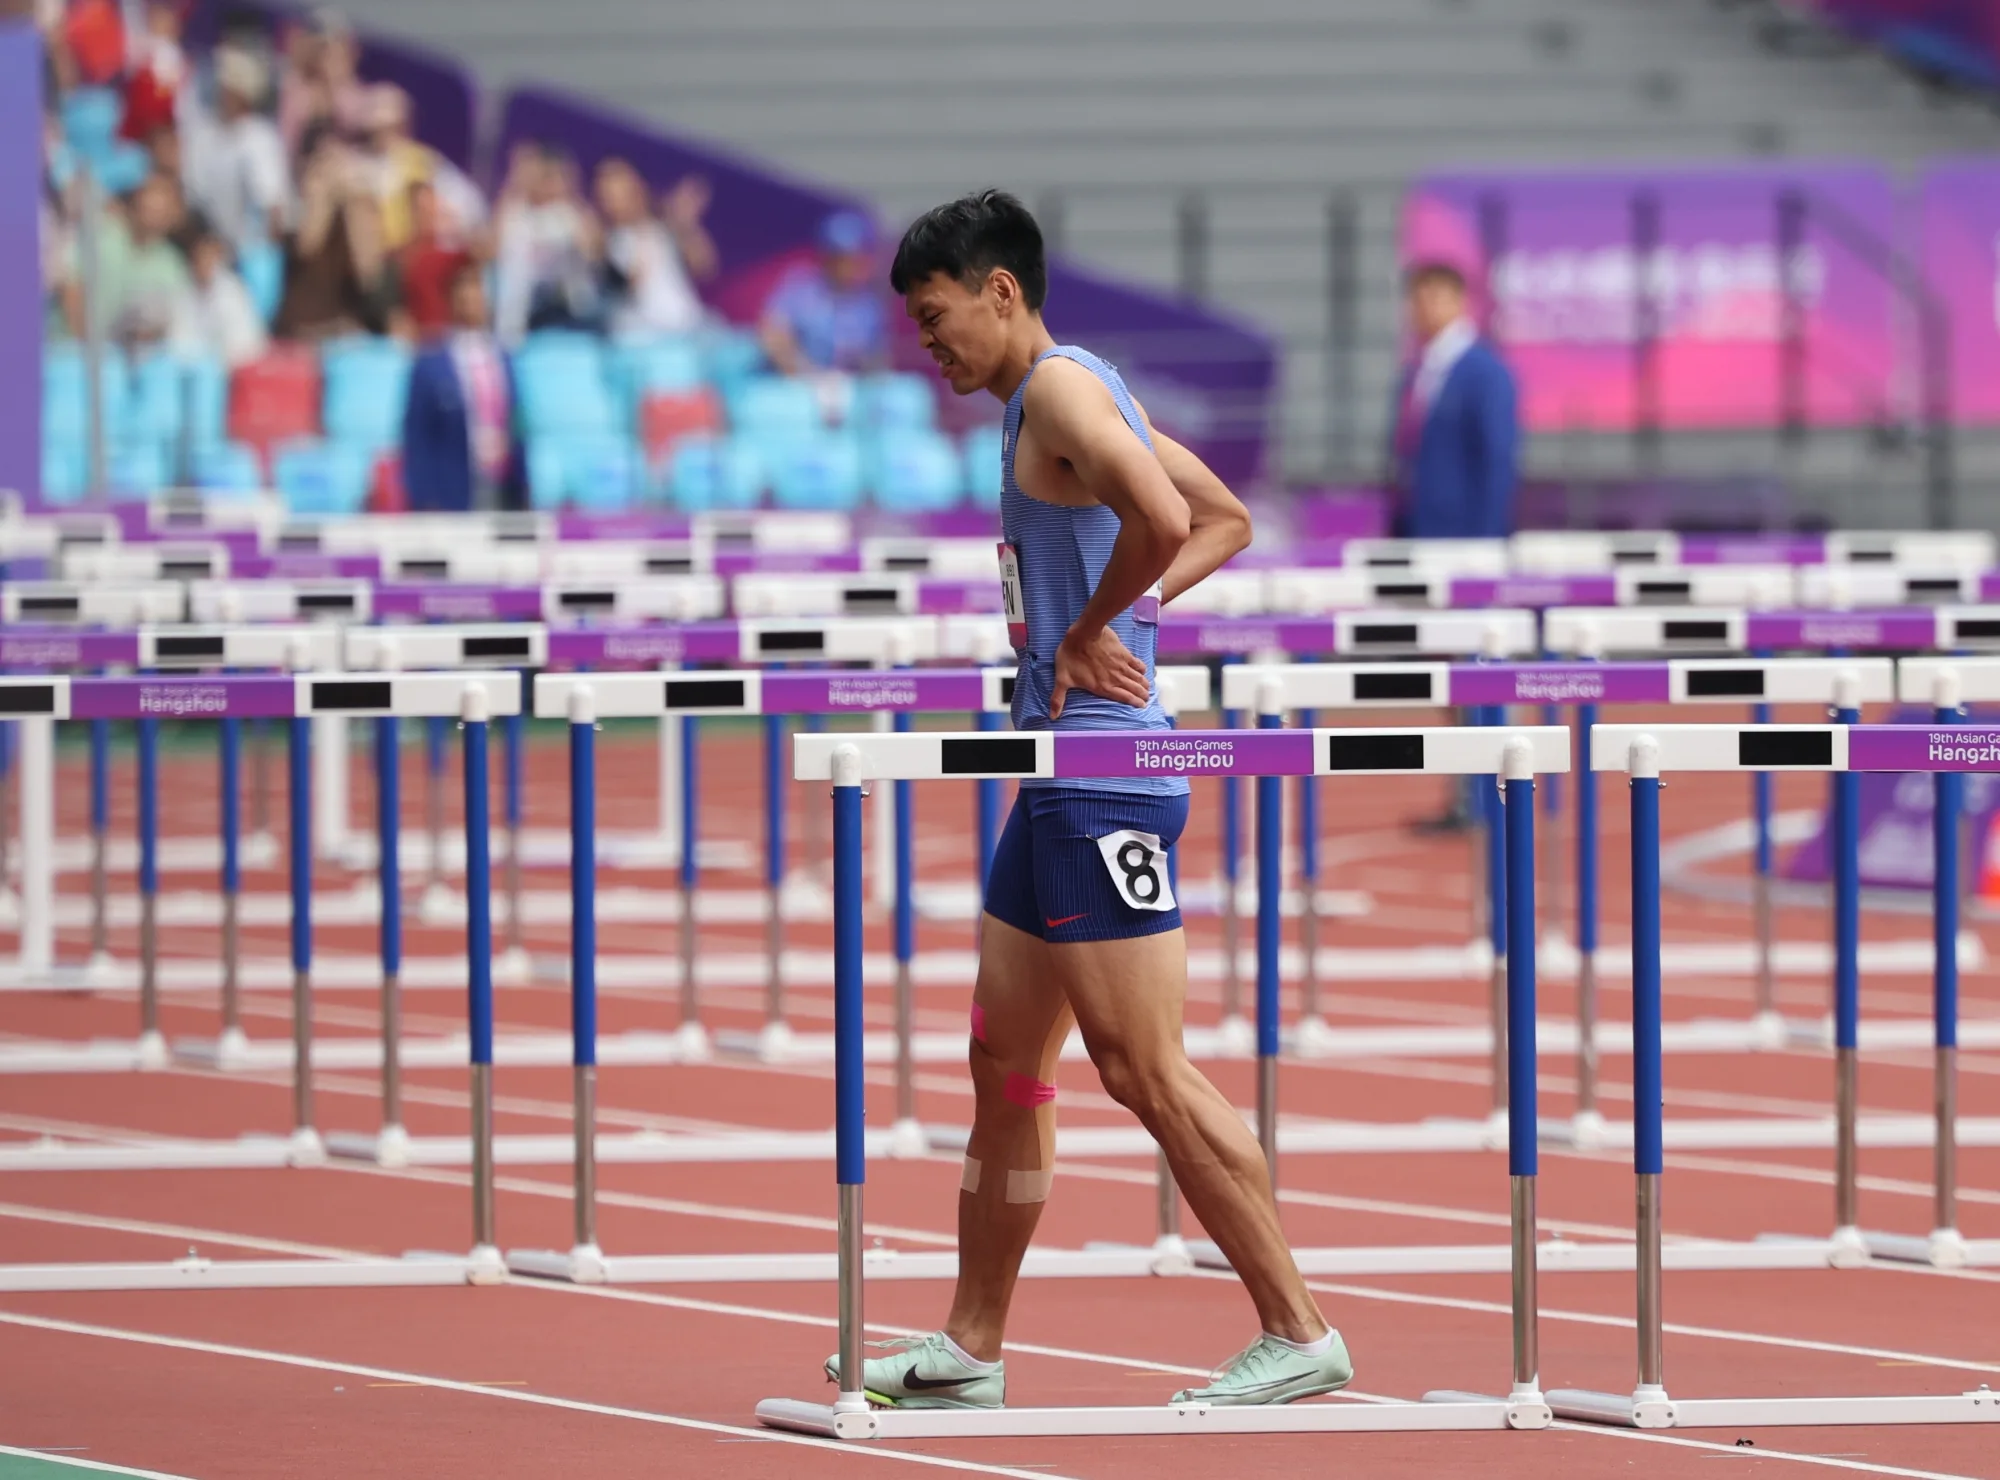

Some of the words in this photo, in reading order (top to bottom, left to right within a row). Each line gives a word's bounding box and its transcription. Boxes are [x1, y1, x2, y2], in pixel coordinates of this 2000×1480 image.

[1134, 740, 1160, 751] 19th
[1161, 740, 1193, 751] Asian
[1194, 740, 1234, 750] Games
[1928, 733, 1953, 743] 19th
[1955, 733, 1986, 743] Asian
[1135, 751, 1234, 771] Hangzhou
[1117, 840, 1160, 905] 8
